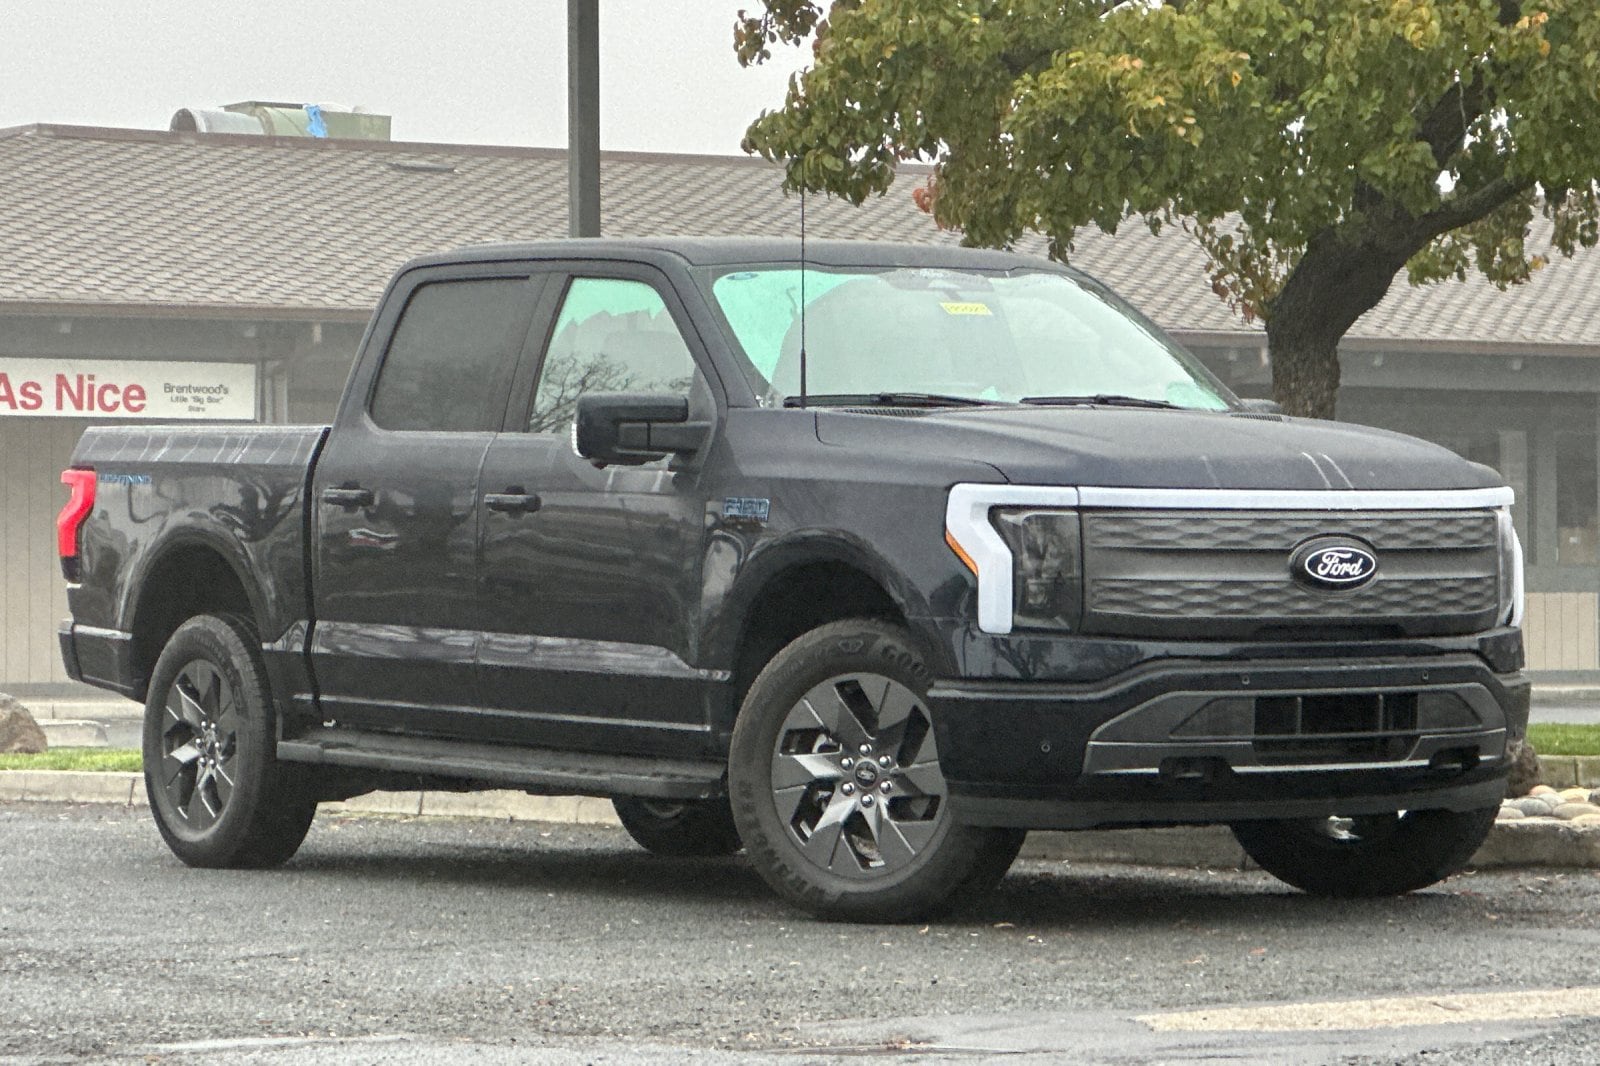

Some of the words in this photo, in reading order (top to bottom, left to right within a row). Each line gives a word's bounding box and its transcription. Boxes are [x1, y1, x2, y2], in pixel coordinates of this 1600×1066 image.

[55, 373, 147, 413] Nice
[163, 382, 229, 395] Brentwood's
[1317, 551, 1364, 576] Ford
